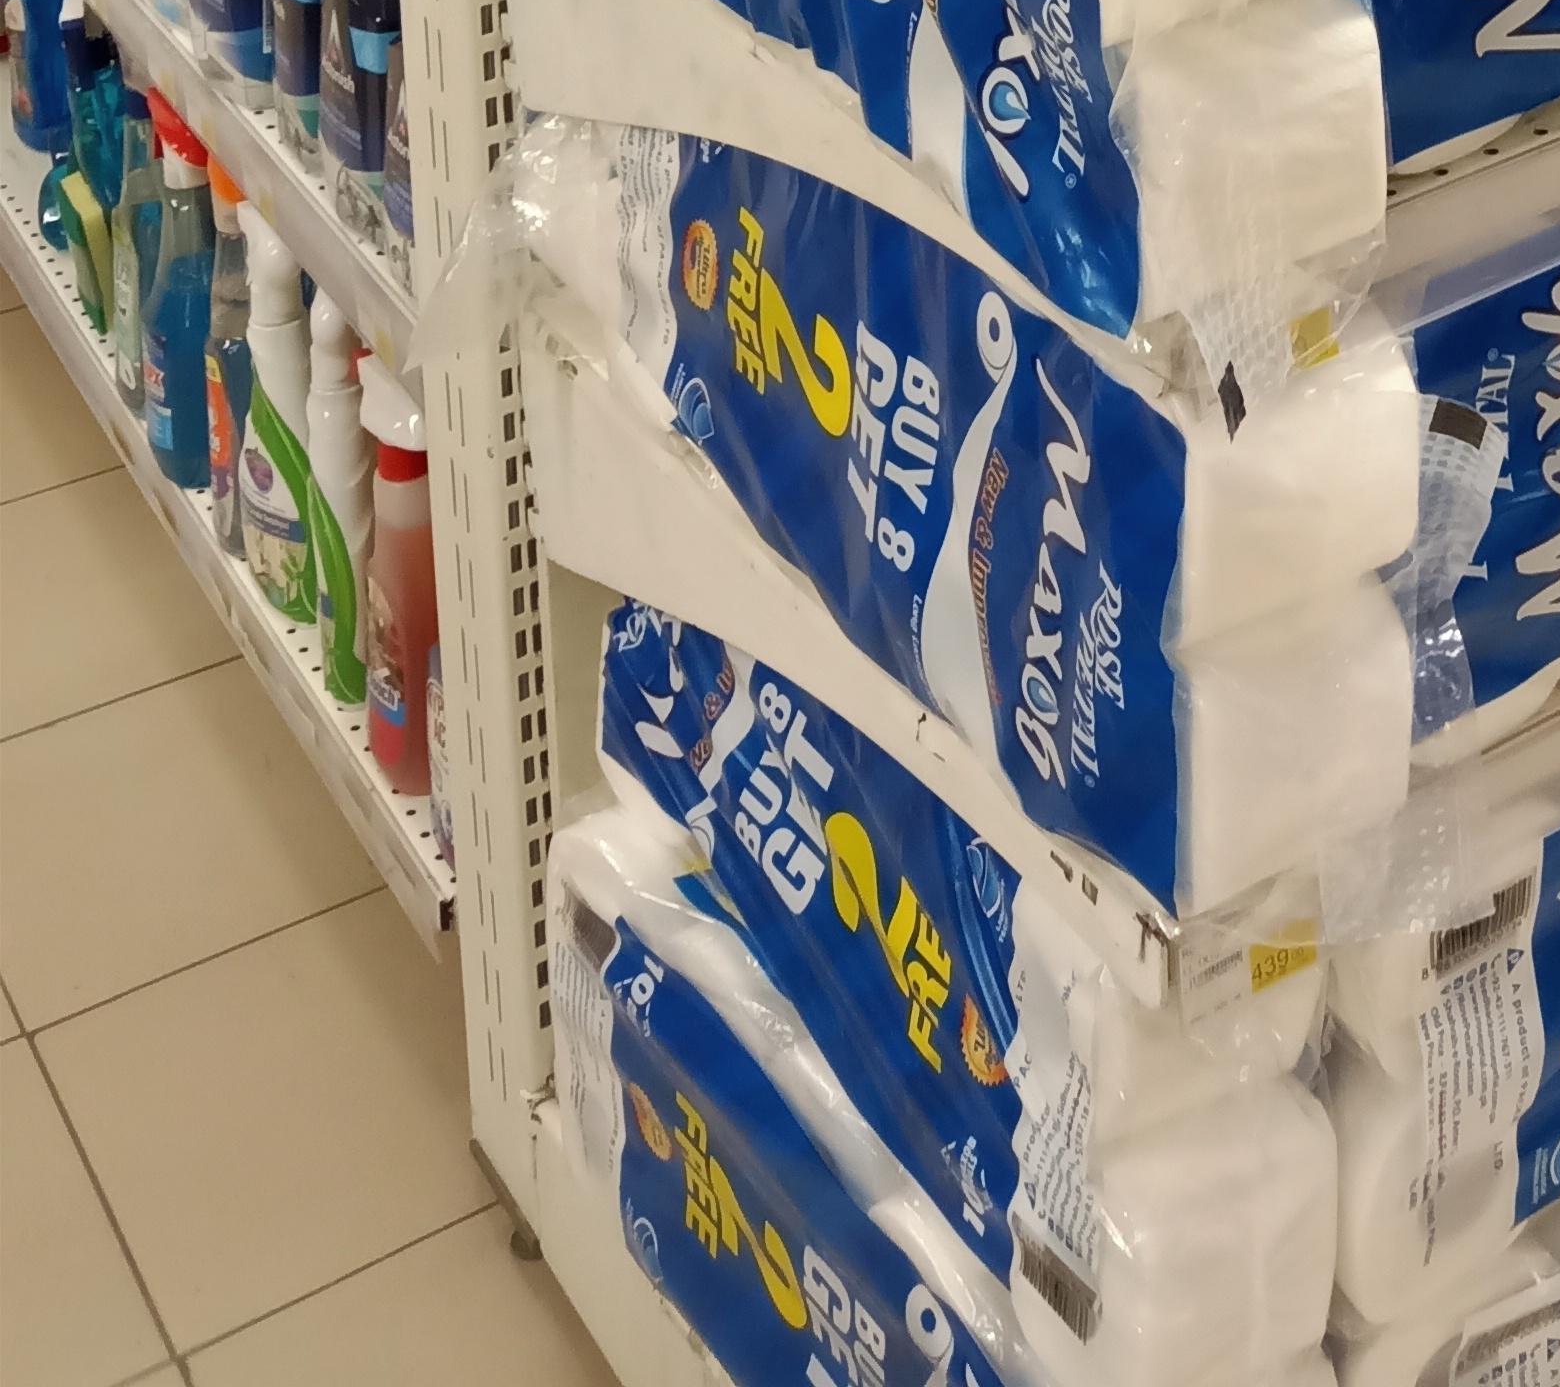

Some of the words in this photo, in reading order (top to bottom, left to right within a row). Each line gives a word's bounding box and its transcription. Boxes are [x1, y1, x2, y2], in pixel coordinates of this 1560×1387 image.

[726, 207, 768, 396] FREE
[883, 354, 940, 515] BUY
[1091, 563, 1125, 711] ROSE
[1251, 948, 1289, 981] 439
